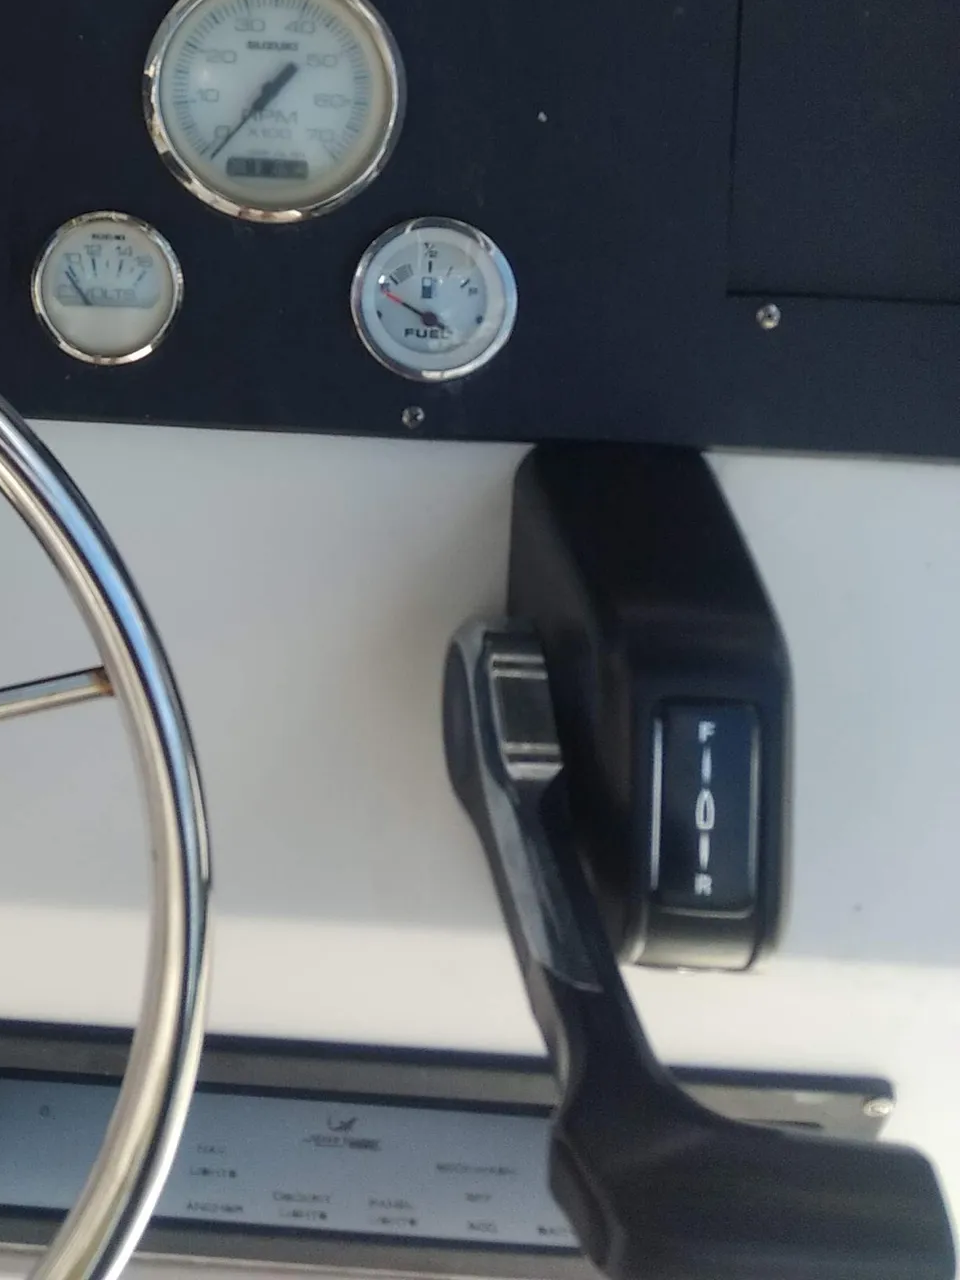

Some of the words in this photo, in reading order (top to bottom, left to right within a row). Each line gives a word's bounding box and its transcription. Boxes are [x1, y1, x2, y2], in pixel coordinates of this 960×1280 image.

[234, 19, 266, 33] 30
[284, 20, 316, 35] 40
[206, 49, 238, 64] 20
[198, 88, 220, 104] 10
[243, 107, 299, 123] RPM
[306, 127, 336, 142] 70
[698, 721, 716, 744] F
[694, 873, 713, 897] R
